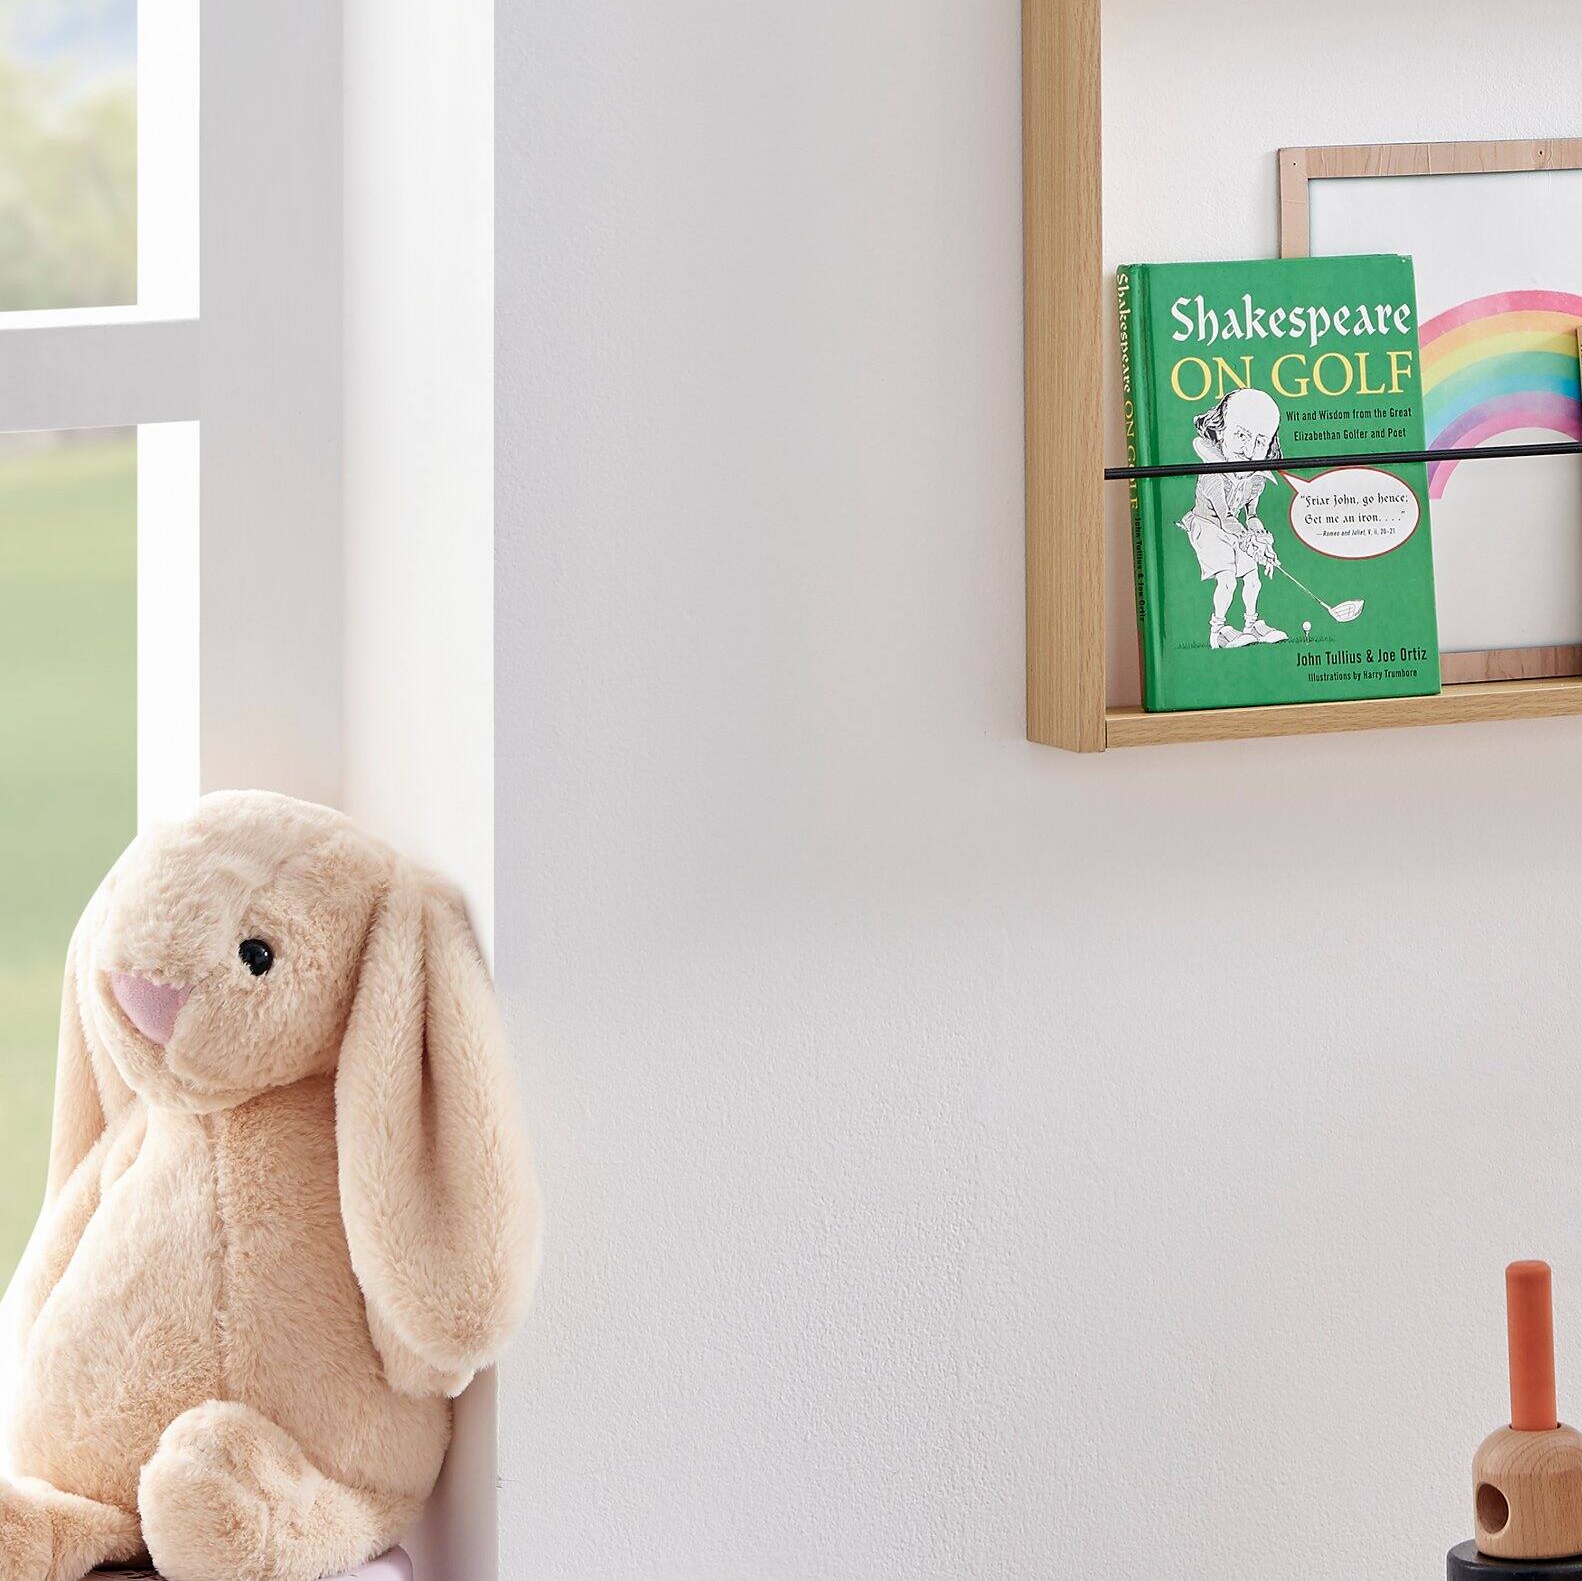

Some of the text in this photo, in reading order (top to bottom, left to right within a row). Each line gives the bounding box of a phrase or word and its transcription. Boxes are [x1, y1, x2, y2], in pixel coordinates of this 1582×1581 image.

[1171, 293, 1413, 347] Shakespeare
[1117, 273, 1131, 394] Shakespeare
[1124, 400, 1135, 438] ON
[1171, 350, 1413, 401] ON GOLF
[1286, 407, 1412, 421] Wit and Wisdom from the Great
[1294, 427, 1406, 441] Elizabethan Golfer and Poet
[1362, 495, 1375, 507] go
[1326, 516, 1339, 524] me
[1343, 515, 1355, 524] an
[1296, 646, 1427, 667] John Tullius & Joe Ortiz
[1308, 669, 1418, 682] Illustrations by Harry Trumbore
